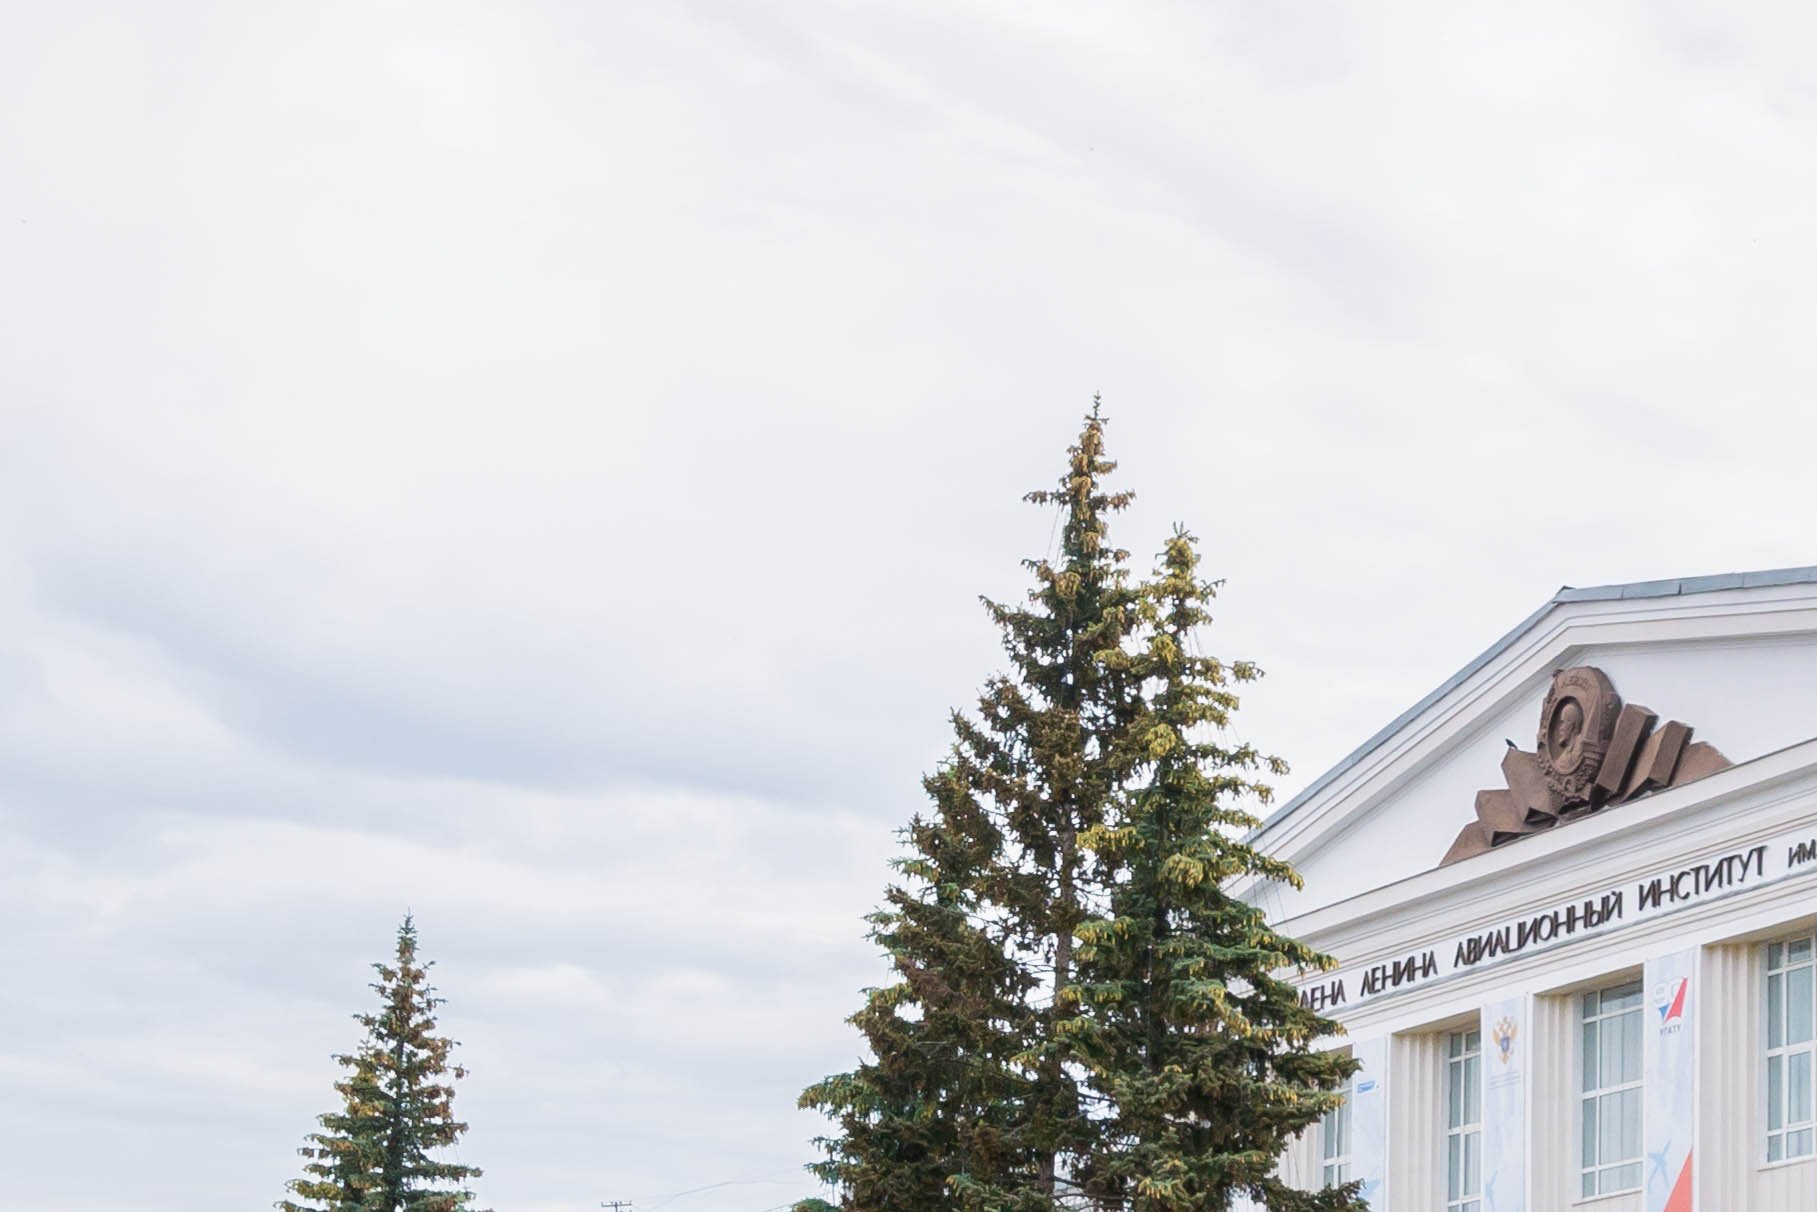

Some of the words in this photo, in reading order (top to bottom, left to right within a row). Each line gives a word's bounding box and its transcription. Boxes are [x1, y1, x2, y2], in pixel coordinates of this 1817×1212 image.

[1300, 978, 1347, 1012] ДЕНА
[1360, 949, 1438, 997] ЛЕНИНА
[1453, 890, 1623, 968] АВИАЦИОННЫЙ
[1638, 844, 1768, 912] ИНСТИТУТ
